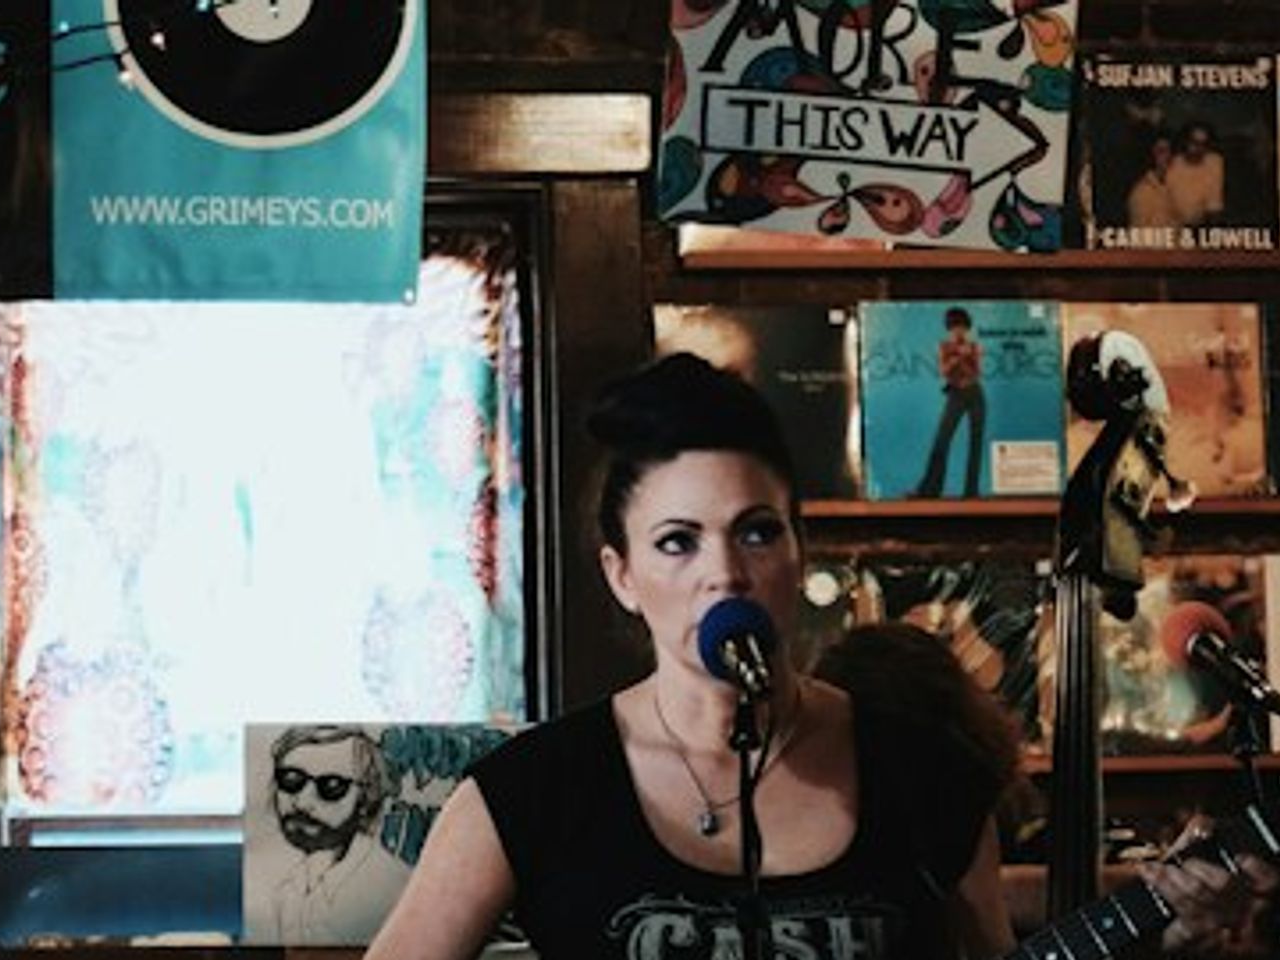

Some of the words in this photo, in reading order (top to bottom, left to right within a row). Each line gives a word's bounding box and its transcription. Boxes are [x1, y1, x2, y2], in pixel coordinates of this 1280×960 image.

[1180, 63, 1269, 88] STEVENS
[726, 97, 869, 151] THIS
[878, 108, 979, 162] WAY
[90, 195, 394, 230] WWW.GRIMEYS.COM
[1199, 226, 1275, 249] LOWELL
